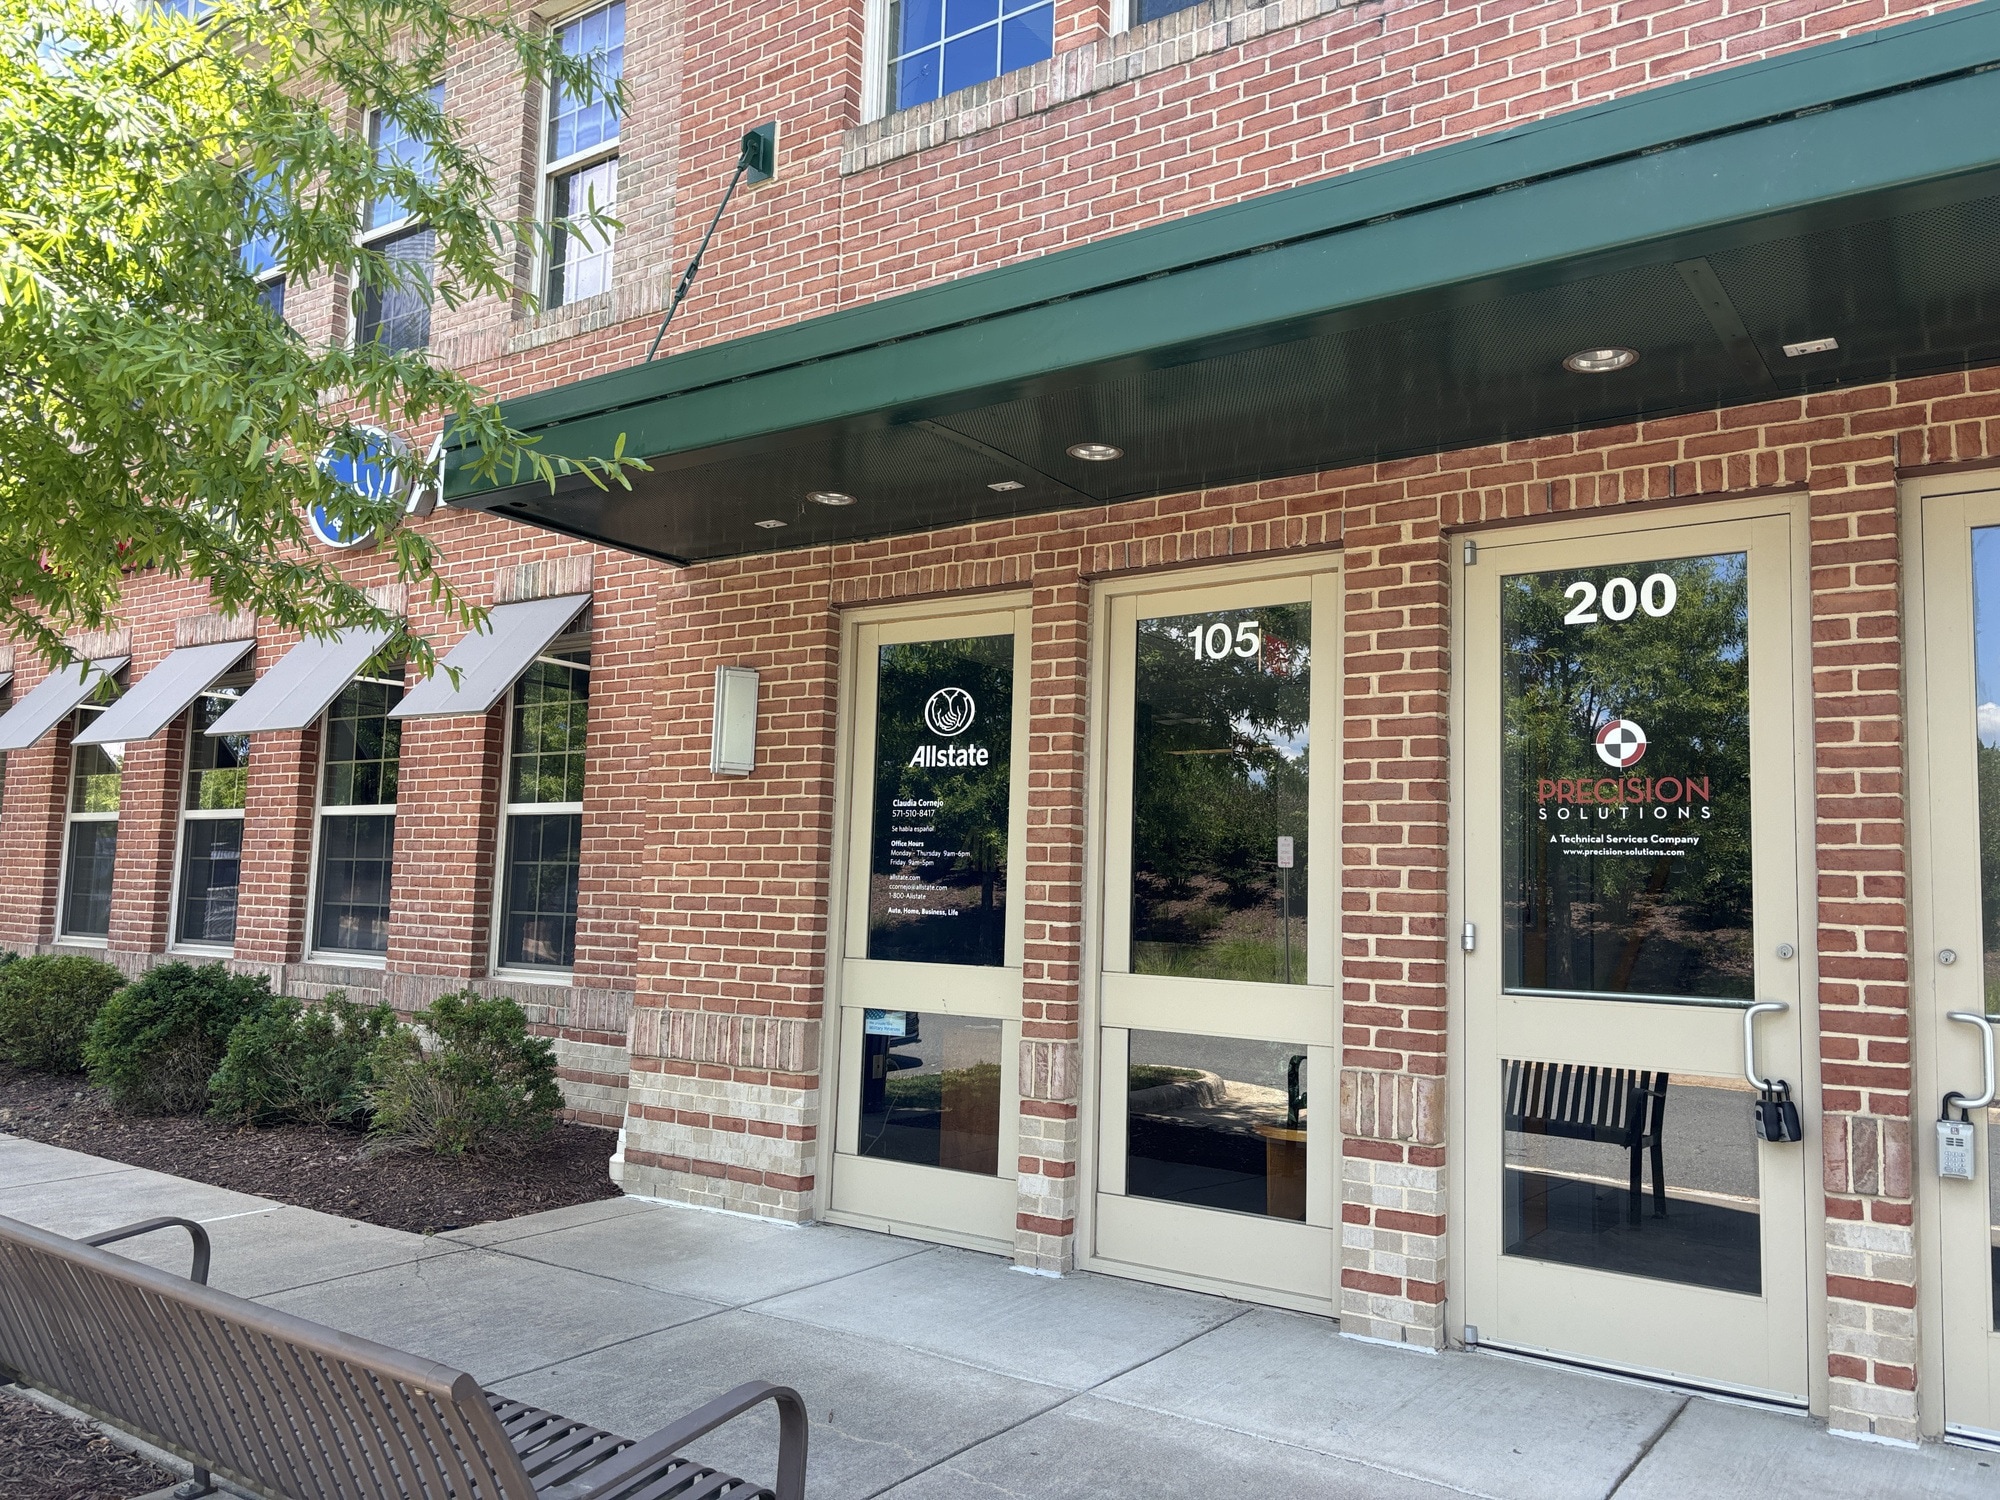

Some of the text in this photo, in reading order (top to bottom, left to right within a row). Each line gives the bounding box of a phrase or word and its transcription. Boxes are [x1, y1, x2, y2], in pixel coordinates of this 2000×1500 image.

[1563, 572, 1677, 625] 200
[1187, 620, 1260, 660] 105
[908, 743, 989, 768] Allstate
[1538, 776, 1710, 804] PRECISION
[892, 799, 944, 808] Claudia Cornejo
[892, 809, 935, 818] 571-510-8417
[1538, 806, 1711, 820] SOLUTIONS
[913, 825, 935, 833] español
[1550, 834, 1700, 846] A Technical Services Company
[890, 849, 912, 857] Monday
[916, 849, 941, 858] Thursday
[943, 850, 971, 858] 9am-6pm
[1563, 847, 1685, 856] www.precision-solutions.com
[890, 859, 935, 867] Friday 9am-5pm
[889, 873, 921, 881] allstate.com
[888, 883, 948, 892] ccornejo@allstate.com
[888, 892, 927, 900] 1-800-Allstate
[887, 907, 902, 915] Auto,
[903, 907, 920, 915] Home,
[921, 908, 947, 916] Business,
